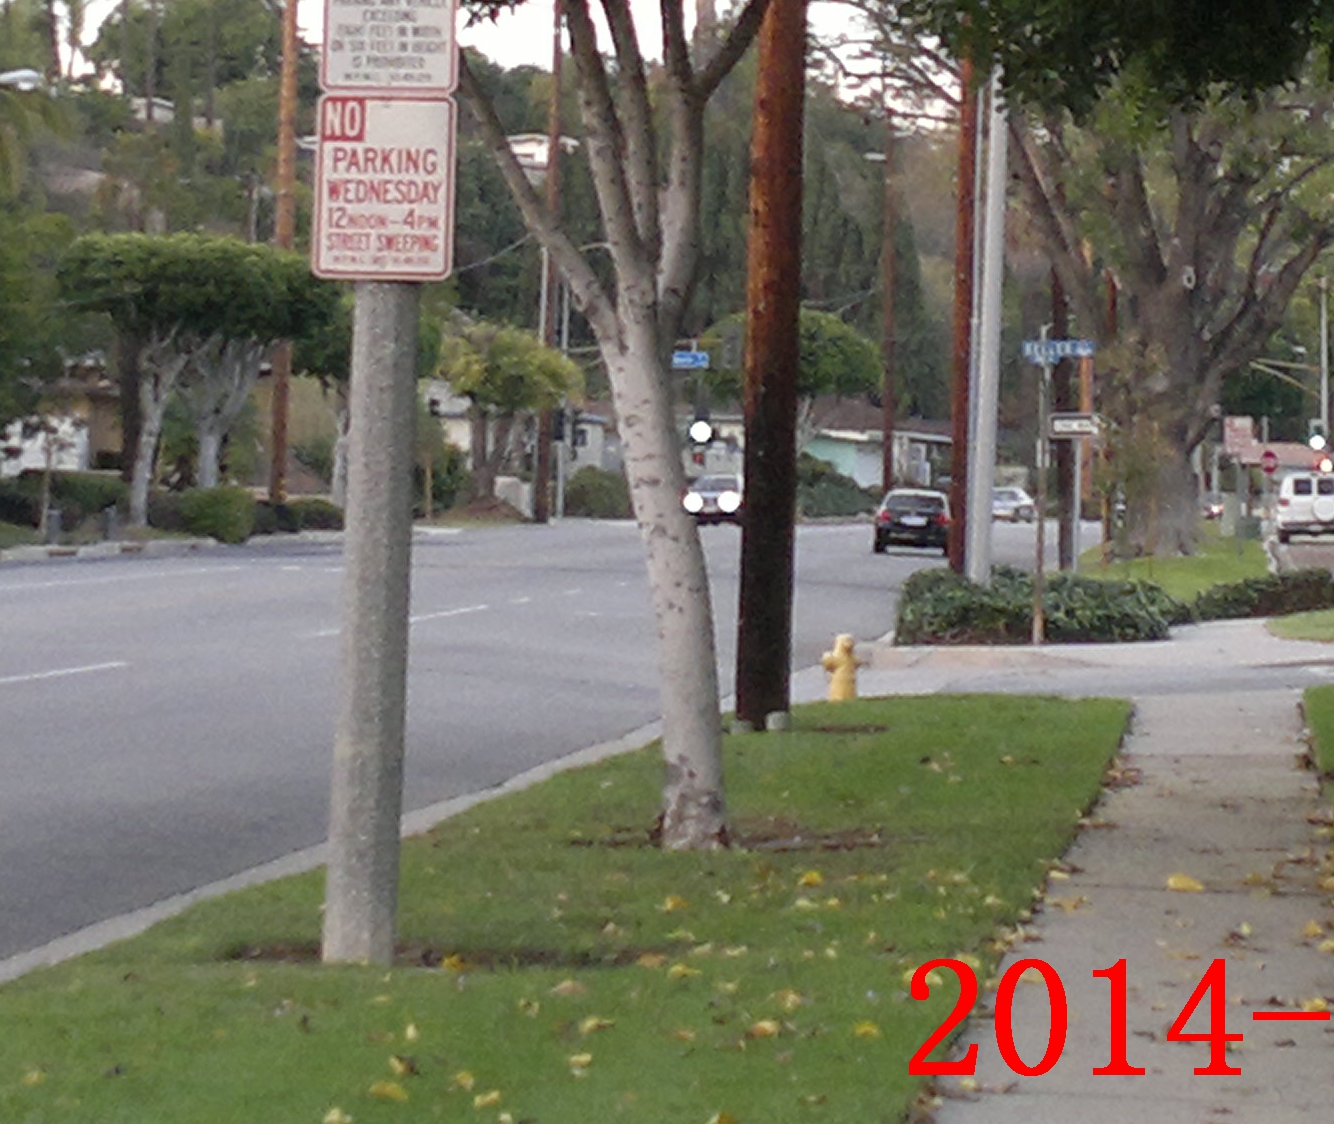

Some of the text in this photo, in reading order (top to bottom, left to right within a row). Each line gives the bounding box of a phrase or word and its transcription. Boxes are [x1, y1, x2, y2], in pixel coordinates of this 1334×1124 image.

[325, 101, 362, 137] NO
[333, 148, 438, 175] PARKING
[327, 180, 443, 204] WEDNESDAY
[327, 233, 440, 253] STREET SWEEPING
